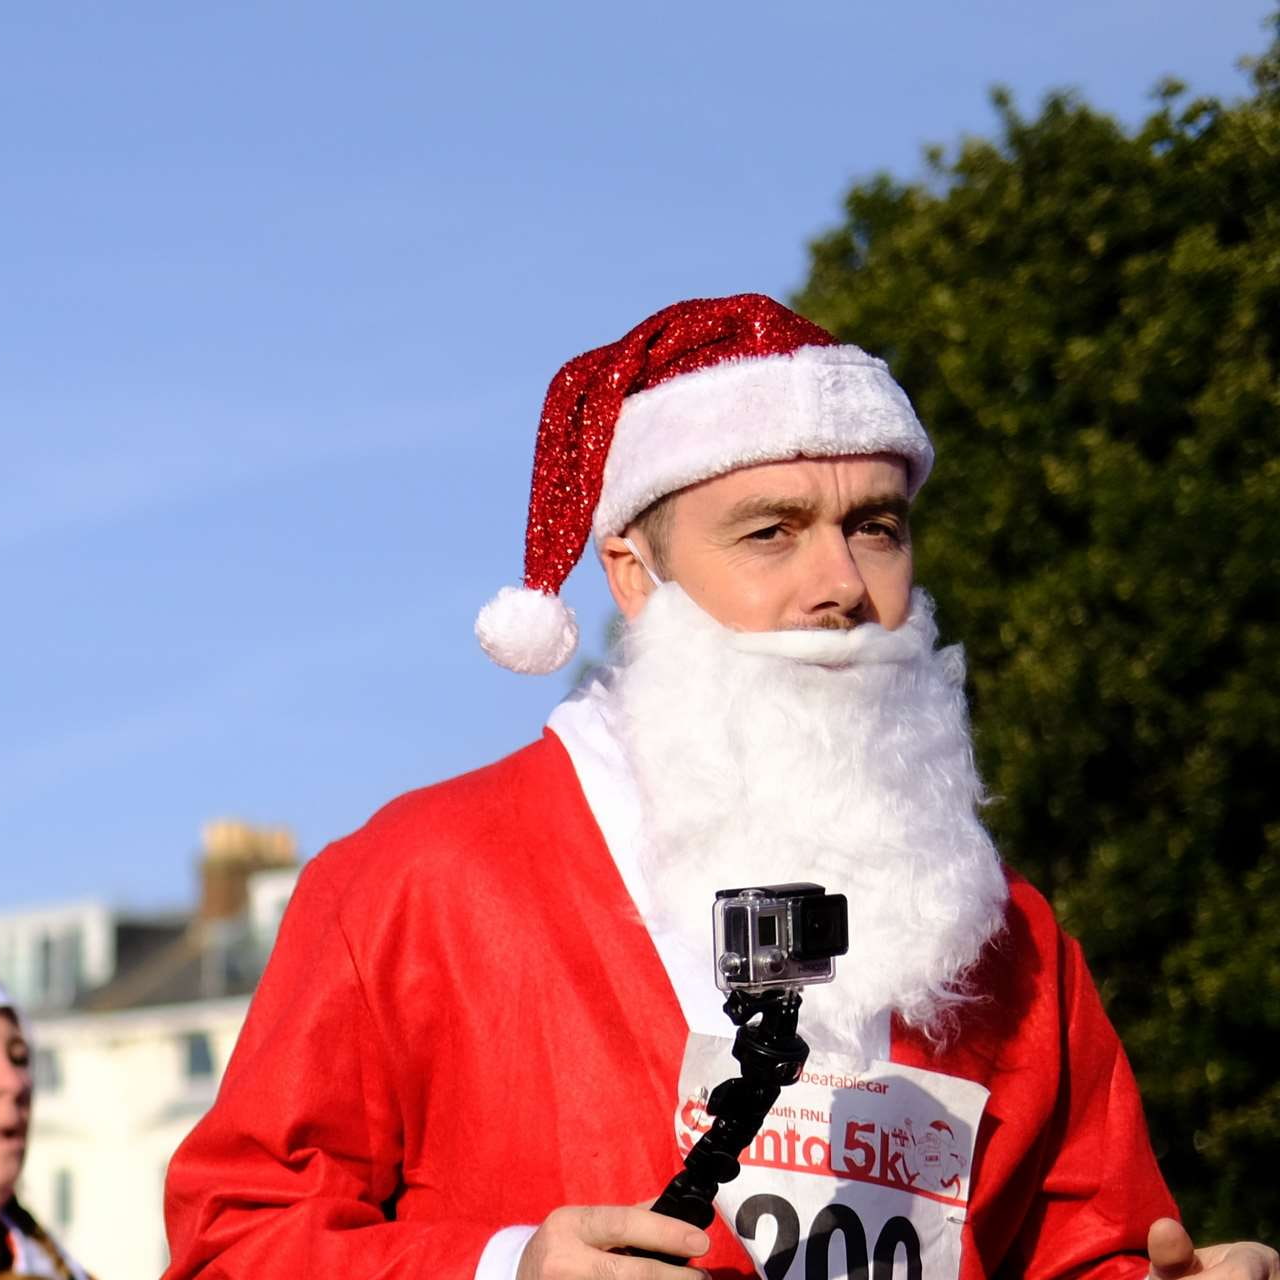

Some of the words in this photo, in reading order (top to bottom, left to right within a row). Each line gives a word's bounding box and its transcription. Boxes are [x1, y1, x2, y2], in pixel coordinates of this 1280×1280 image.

[800, 1071, 889, 1095] beatablecar
[800, 1108, 833, 1124] RNLI
[680, 1098, 832, 1167] Snta
